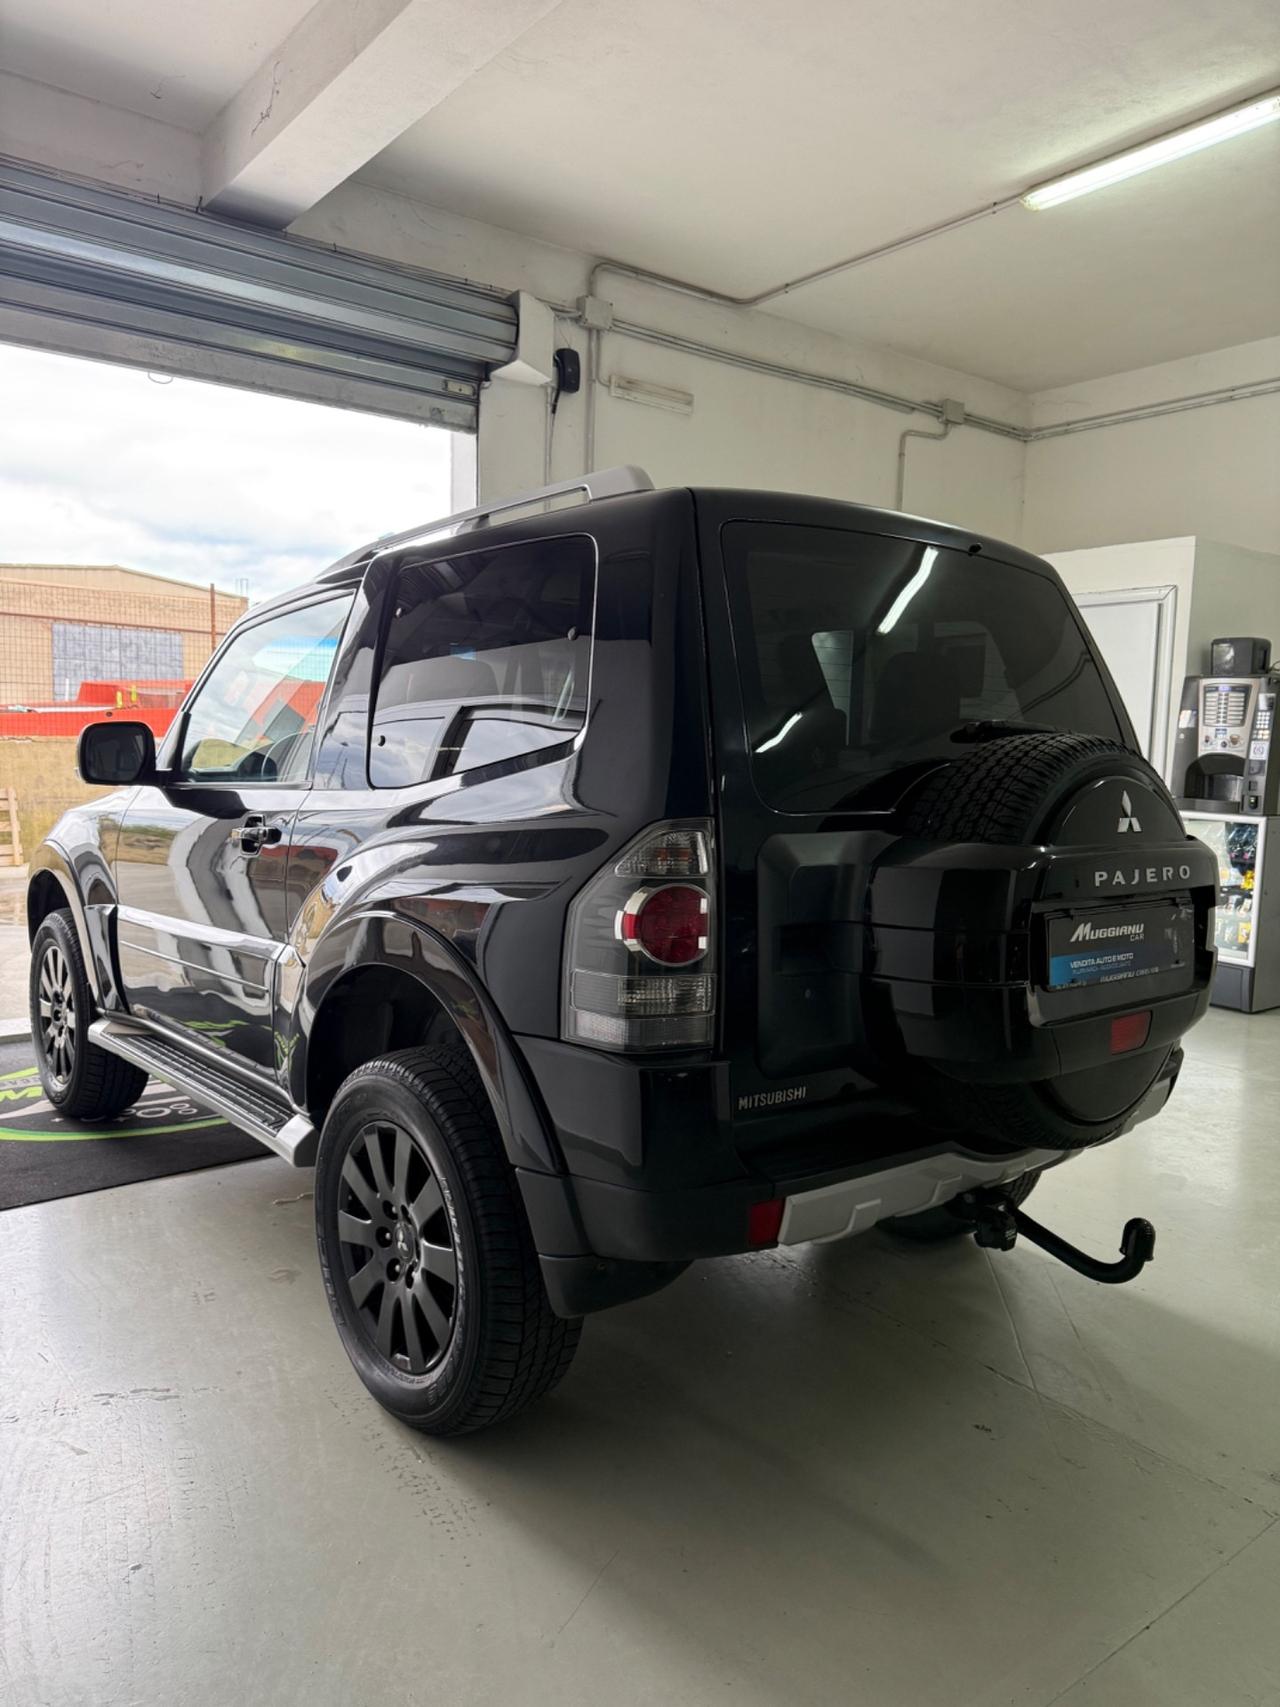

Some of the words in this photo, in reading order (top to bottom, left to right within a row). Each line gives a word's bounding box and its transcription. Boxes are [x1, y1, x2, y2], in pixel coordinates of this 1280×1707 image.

[1094, 865, 1191, 887] PAJERO
[1070, 922, 1145, 942] MUGGIANU
[1130, 933, 1145, 942] CAR
[738, 1086, 807, 1110] MITSUBISHI
